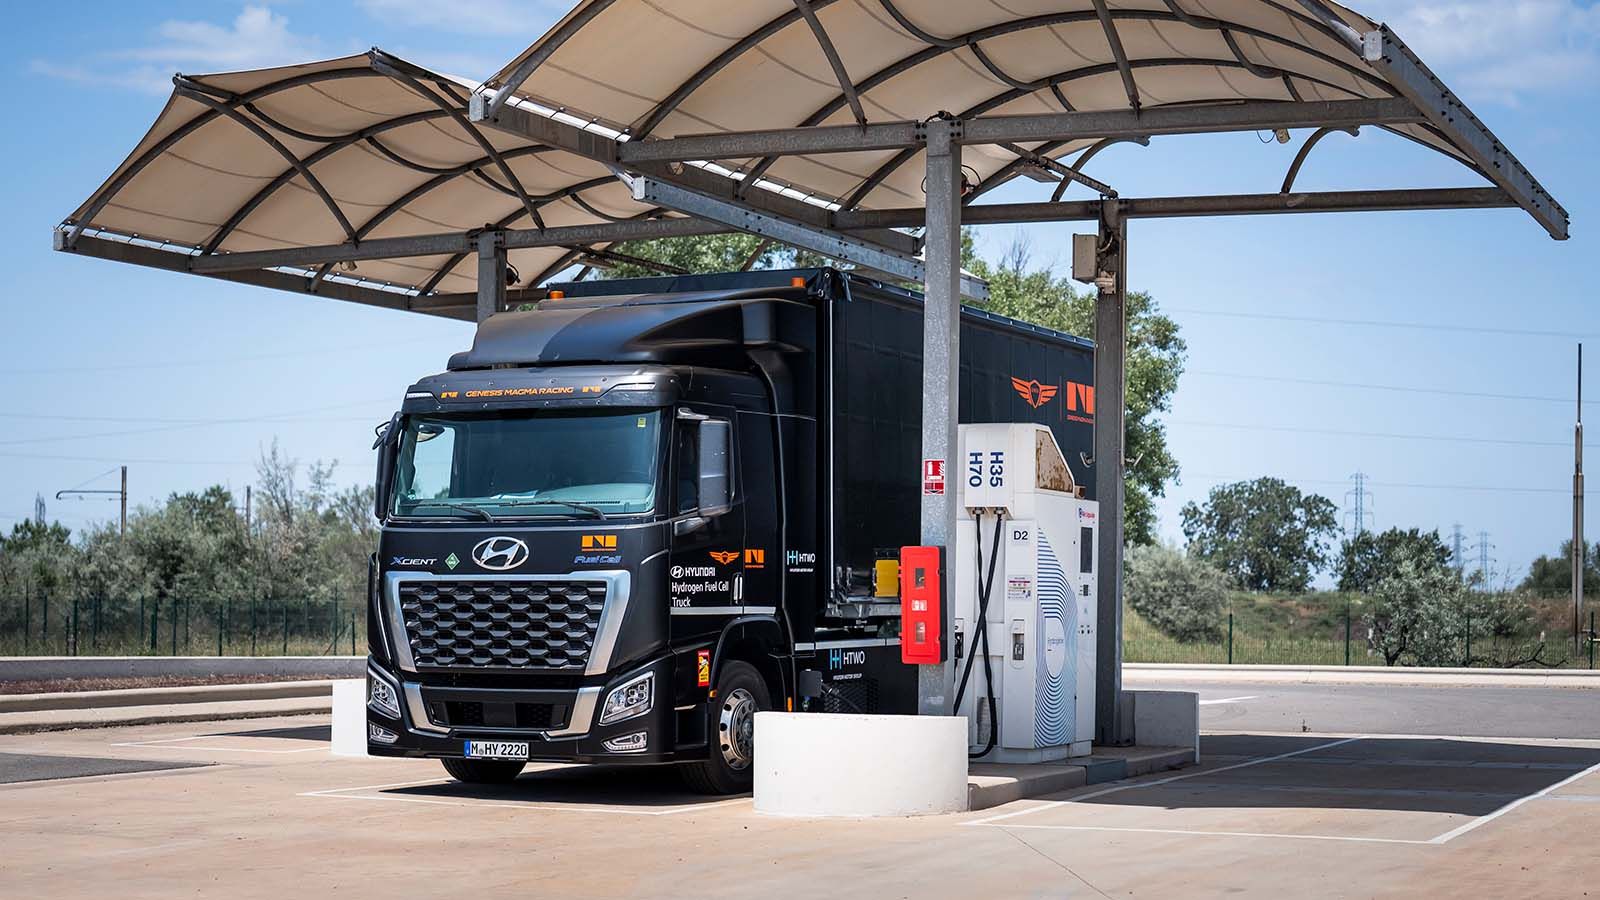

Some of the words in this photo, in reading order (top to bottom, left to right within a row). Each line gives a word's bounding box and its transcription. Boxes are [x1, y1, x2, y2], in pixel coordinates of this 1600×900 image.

[465, 389, 503, 398] GENESIS
[504, 388, 539, 396] MAGMA
[539, 386, 574, 395] RACING
[969, 452, 983, 488] H70
[990, 452, 1004, 488] H35
[1013, 530, 1028, 541] D2
[390, 556, 438, 566] XCIENT
[685, 567, 716, 577] HYUNDAI
[671, 582, 704, 595] Hydrogen
[704, 581, 718, 592] Fuel
[718, 581, 729, 592] Cell
[671, 596, 691, 607] Truck
[843, 651, 865, 665] HTWO
[484, 743, 499, 755] HY
[501, 744, 527, 756] 2220
